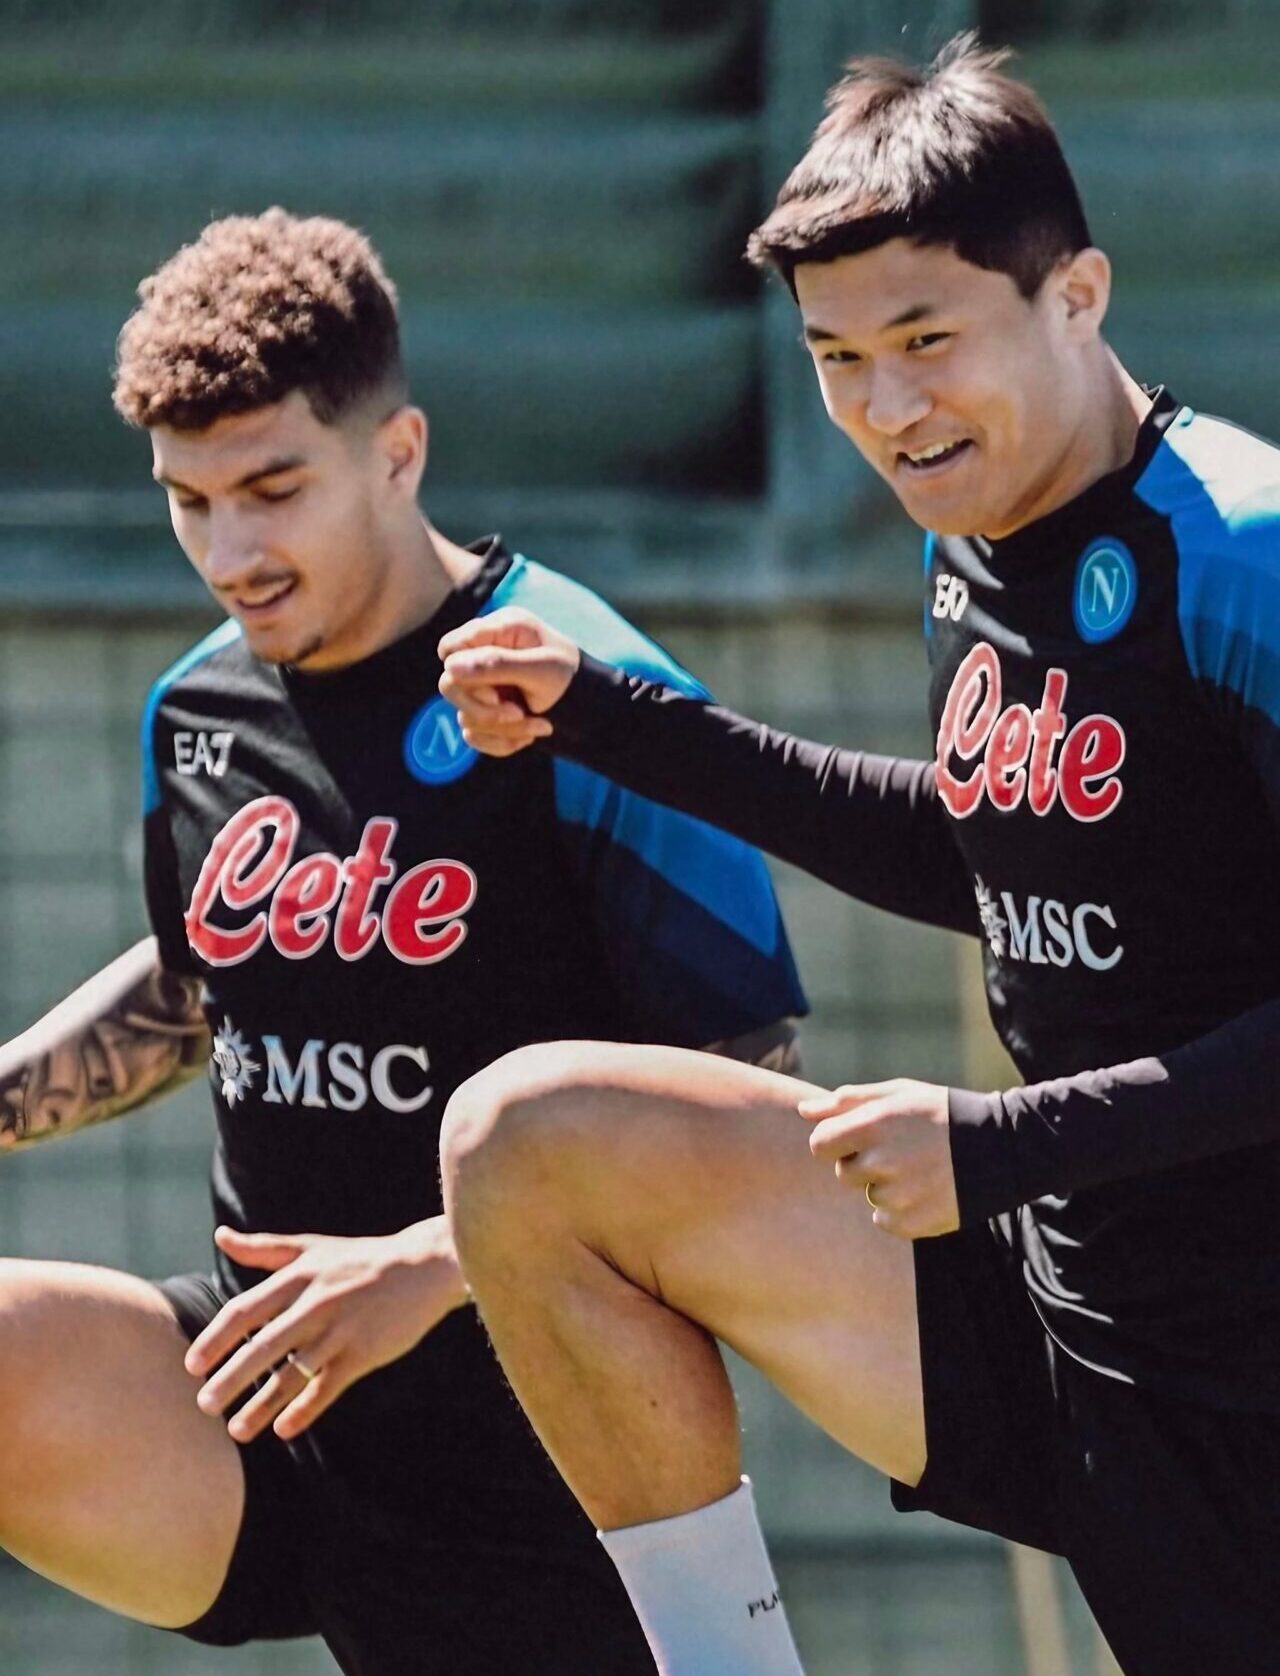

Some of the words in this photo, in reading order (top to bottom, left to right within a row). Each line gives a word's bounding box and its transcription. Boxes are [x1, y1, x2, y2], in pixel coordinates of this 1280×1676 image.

[1087, 566, 1119, 615] N
[173, 732, 234, 776] EA7
[935, 641, 1125, 822] Lete
[184, 795, 477, 966] Lete
[1001, 892, 1123, 970] MSC
[261, 1035, 433, 1112] MSC
